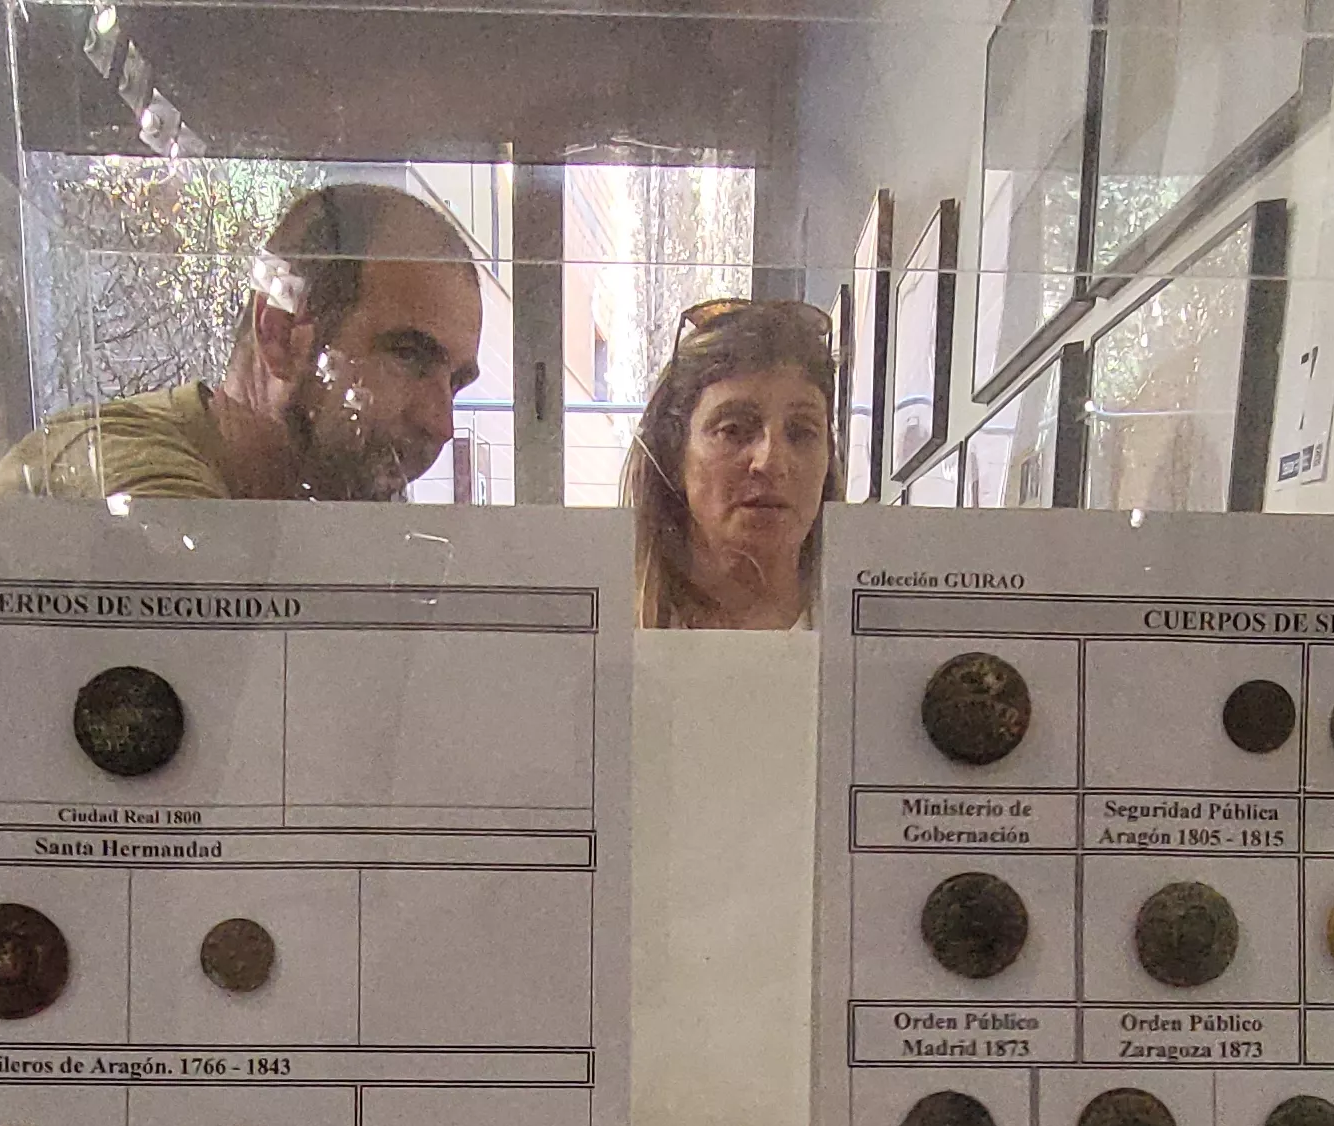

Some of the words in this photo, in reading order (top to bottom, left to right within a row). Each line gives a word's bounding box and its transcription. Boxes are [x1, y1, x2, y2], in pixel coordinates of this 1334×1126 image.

[856, 570, 938, 587] Colección
[943, 572, 1025, 590] GUIRAO
[97, 595, 132, 617] DE
[140, 596, 301, 618] SEGURIDAD
[1144, 609, 1266, 632] CUERPOS
[1274, 612, 1308, 633] DE
[57, 808, 119, 825] Ciudad
[124, 809, 160, 824] Real
[166, 810, 202, 824] 1800
[902, 798, 1004, 817] Ministerio
[1008, 799, 1033, 817] de
[1104, 800, 1202, 823] Seguridad
[1208, 802, 1279, 821] Pública
[902, 824, 1031, 845] Gobernación
[1099, 827, 1171, 849] Aragón
[1179, 828, 1221, 846] 1805
[1241, 829, 1285, 847] 1815
[34, 838, 94, 857] Santa
[102, 839, 223, 858] Hermandad
[893, 1011, 958, 1031] Orden
[964, 1012, 1040, 1031] Público
[1119, 1013, 1183, 1032] Orden
[1189, 1013, 1264, 1032] Público
[902, 1038, 978, 1057] Madrid
[985, 1038, 1031, 1057] 1873
[1119, 1040, 1212, 1061] Zaragoza
[1220, 1041, 1263, 1059] 1873
[59, 1056, 85, 1075] de
[90, 1057, 173, 1079] Aragón.
[180, 1057, 227, 1076] 1766
[248, 1057, 291, 1077] 1843
